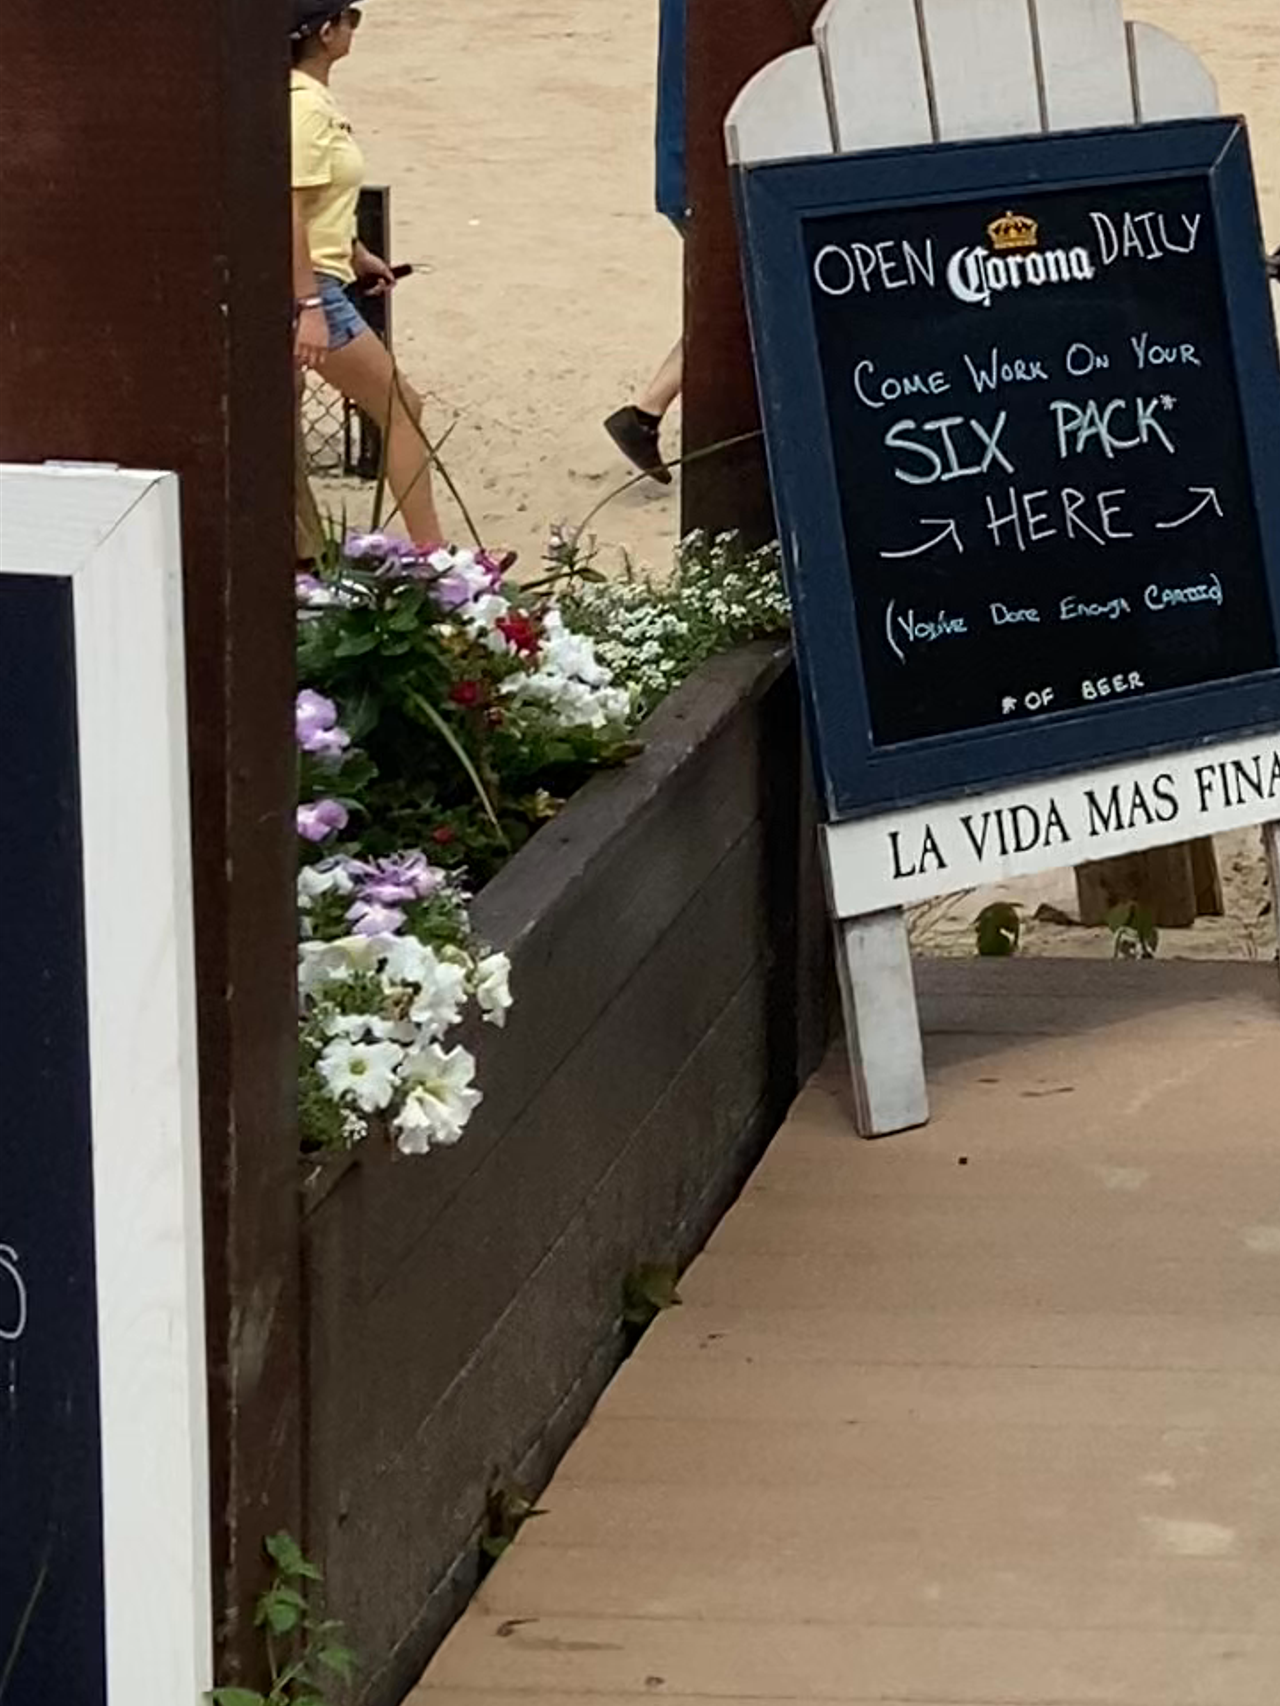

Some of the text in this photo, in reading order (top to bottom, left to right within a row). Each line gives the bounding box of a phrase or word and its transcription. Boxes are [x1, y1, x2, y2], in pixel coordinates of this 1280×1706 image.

[813, 211, 1201, 295] OPEN DAILY
[946, 245, 1096, 307] Corona
[884, 410, 1015, 485] SIX
[986, 487, 1134, 552] HERE
[1081, 670, 1145, 701] BEER
[888, 823, 948, 880] LA
[959, 797, 1071, 861] VIDA
[1083, 772, 1180, 837] MAS
